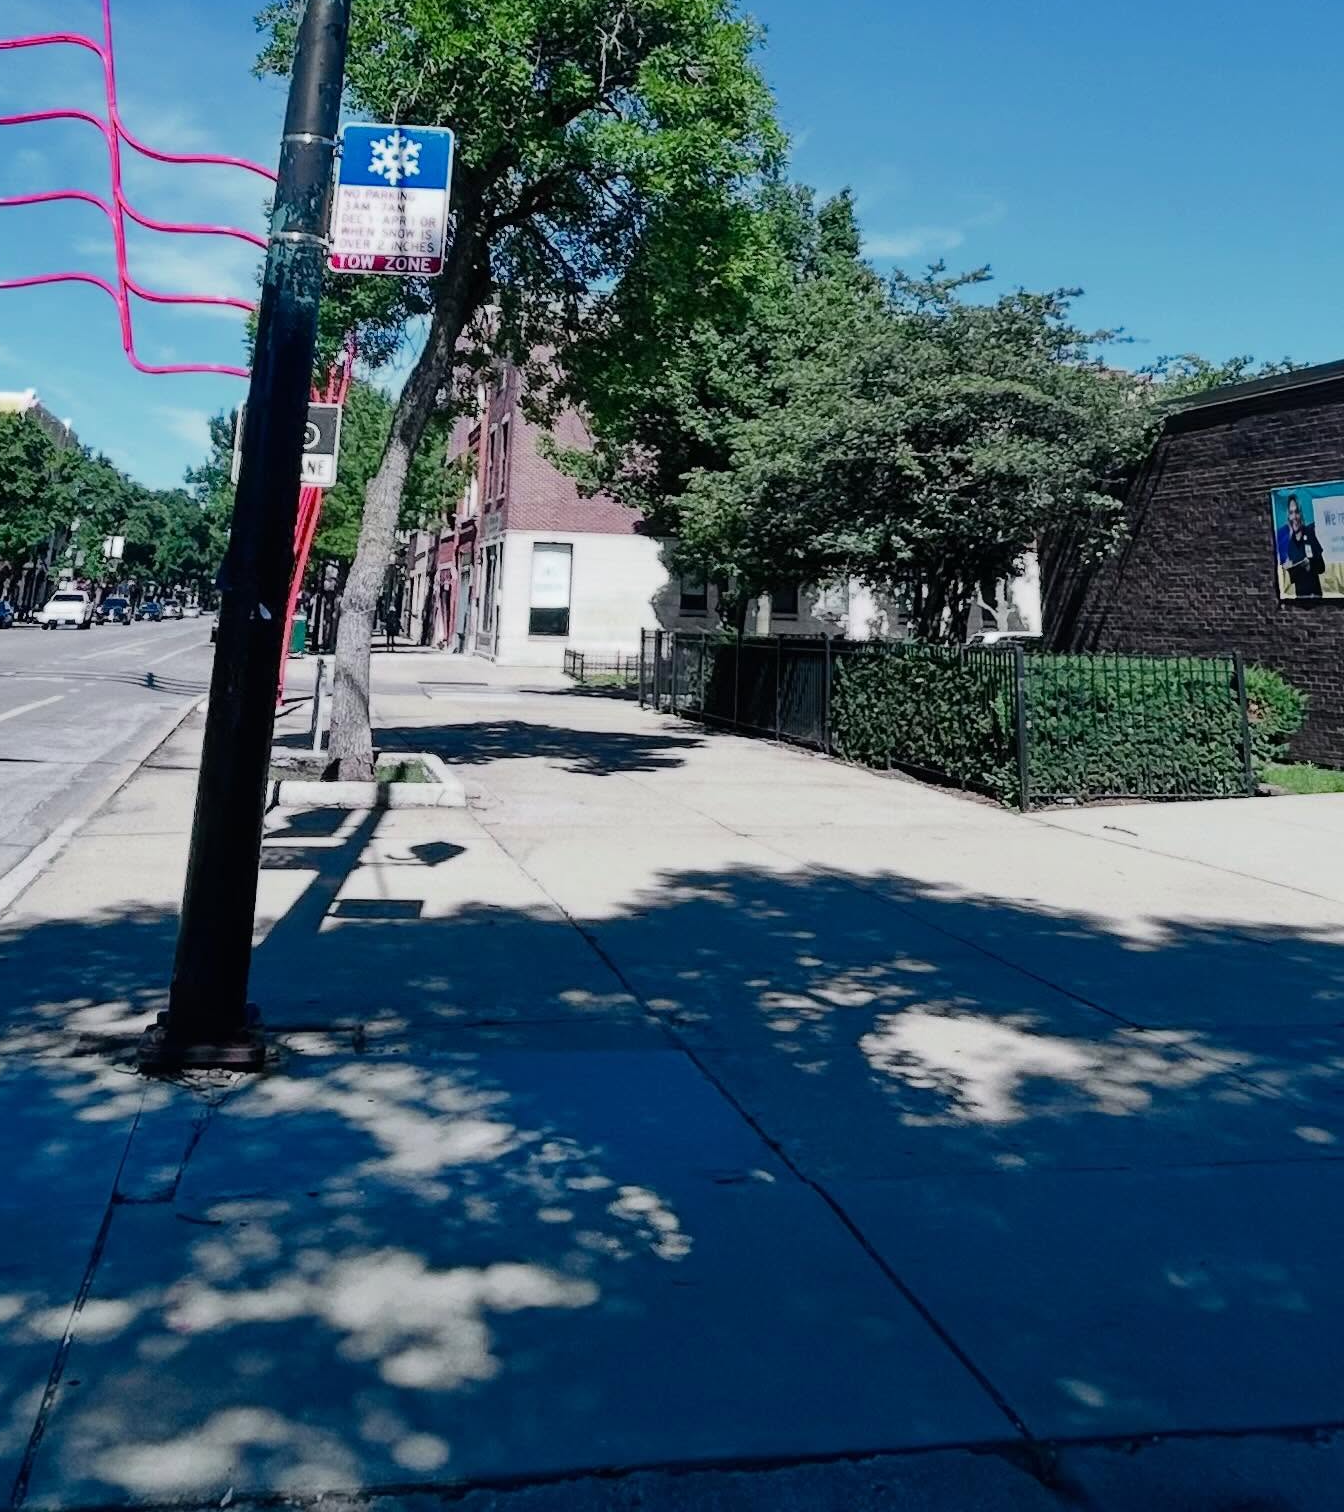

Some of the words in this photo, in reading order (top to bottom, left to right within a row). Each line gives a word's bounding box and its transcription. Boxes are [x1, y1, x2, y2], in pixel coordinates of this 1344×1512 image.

[343, 190, 360, 199] NO
[366, 190, 416, 201] PARKING
[383, 215, 406, 226] APR
[420, 216, 436, 228] OR
[341, 227, 374, 237] WHEN
[382, 228, 415, 239] SNOW
[421, 229, 432, 240] IS
[339, 239, 370, 249] OVER
[377, 240, 385, 250] 2
[391, 241, 435, 253] INCHES
[339, 255, 375, 269] TOW
[385, 256, 432, 272] ZONE
